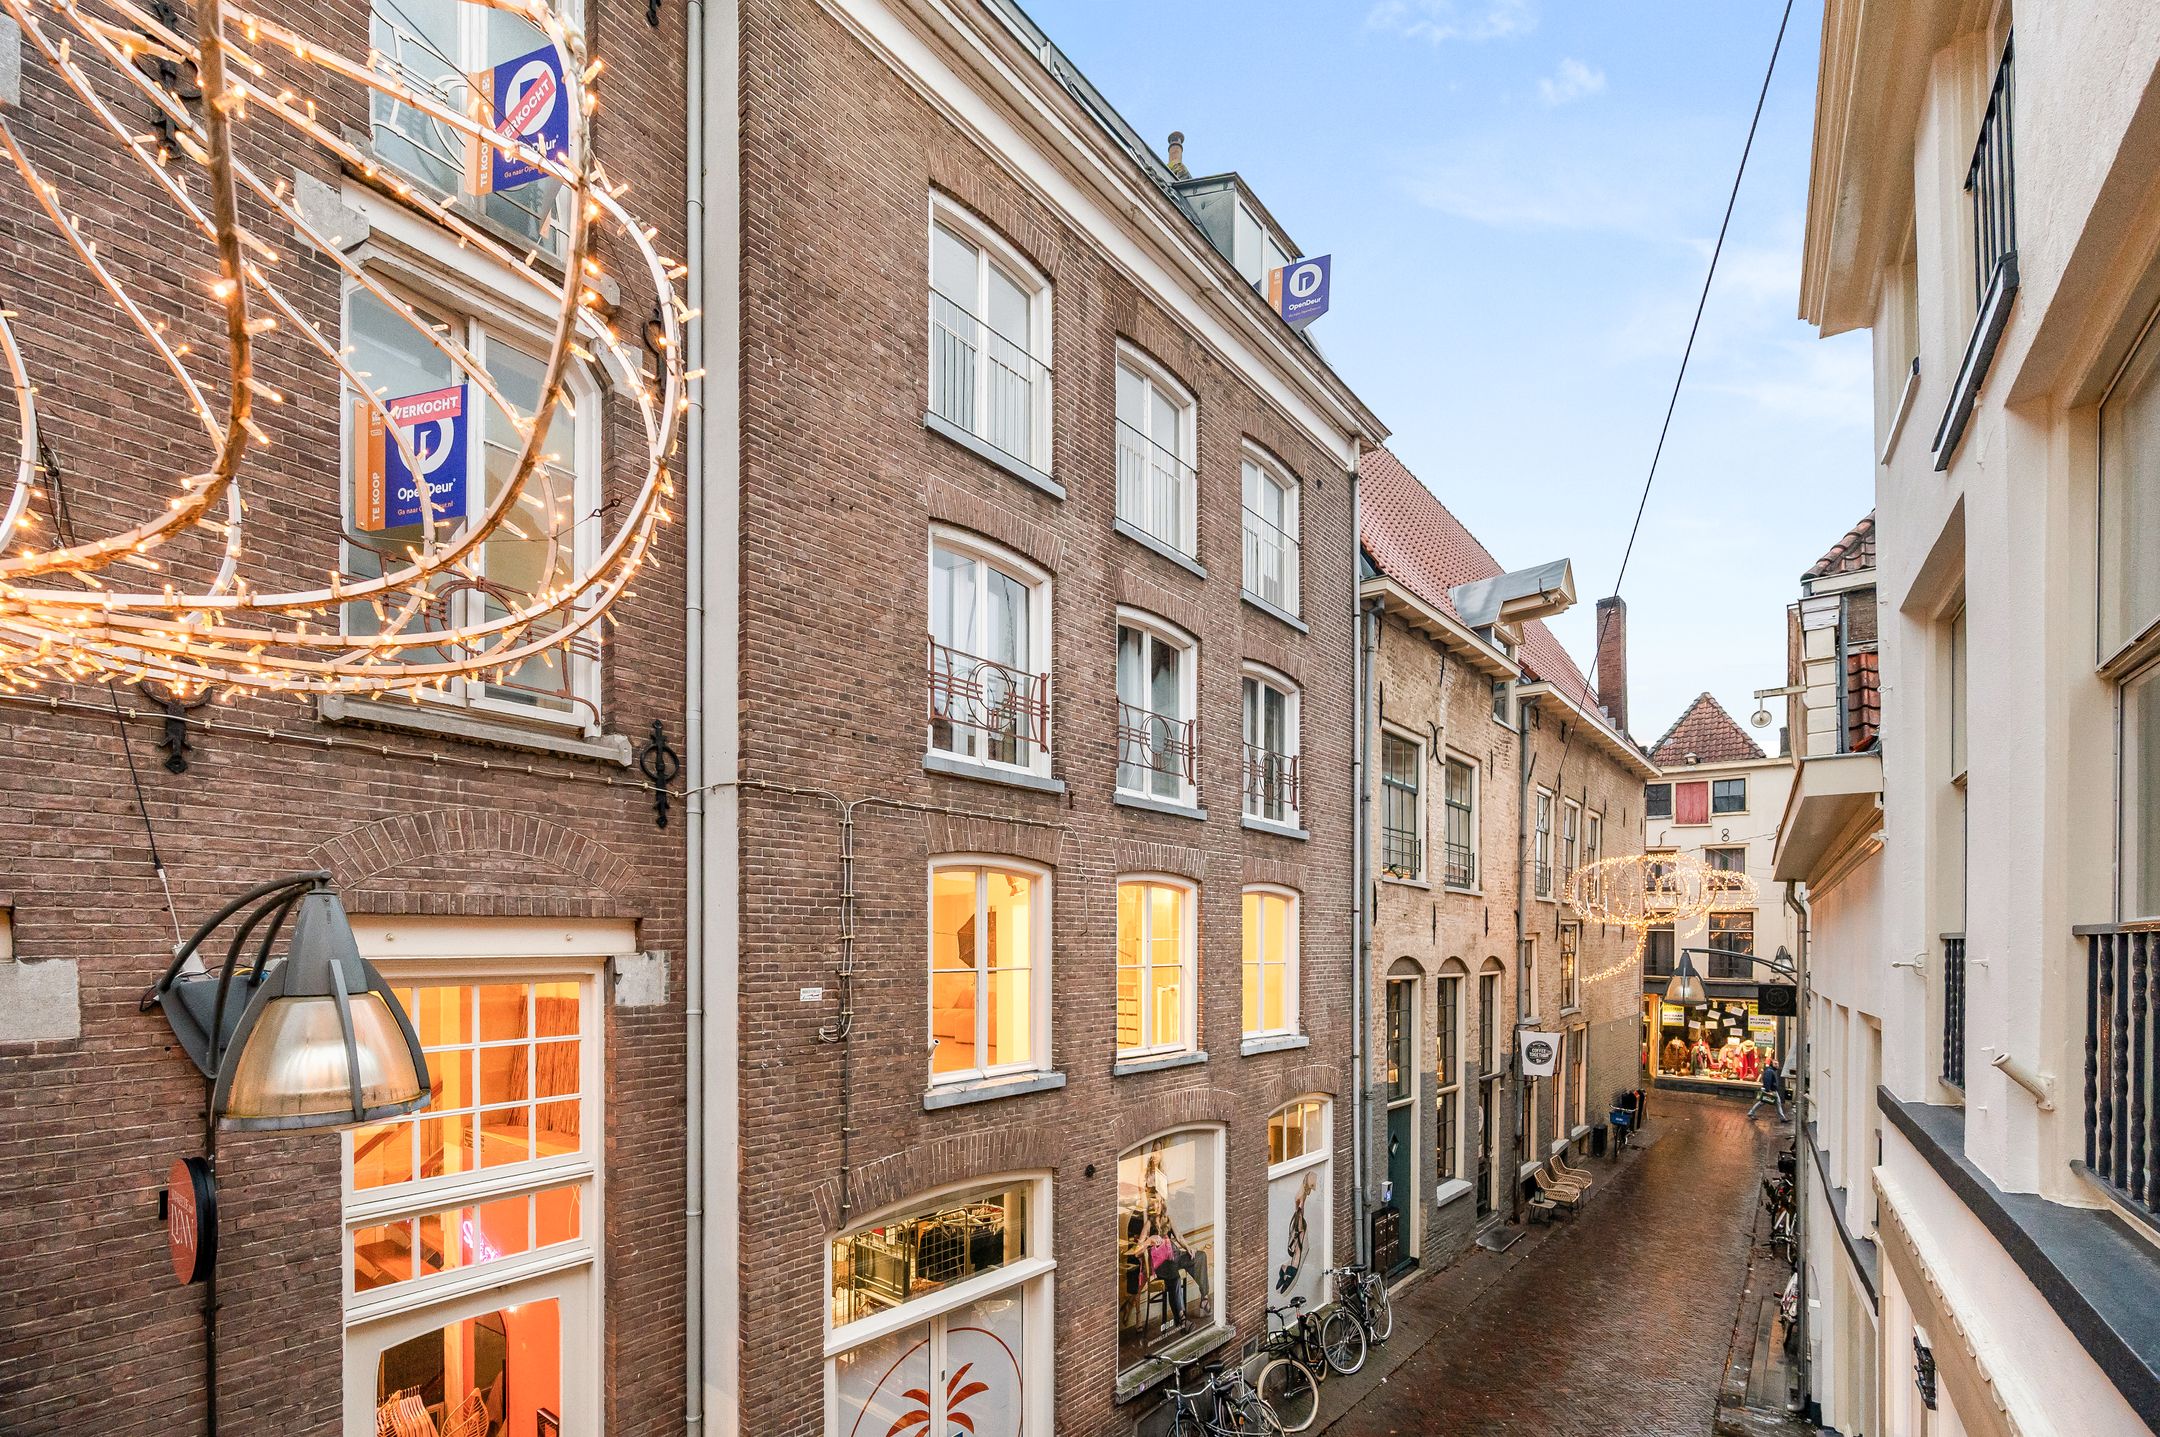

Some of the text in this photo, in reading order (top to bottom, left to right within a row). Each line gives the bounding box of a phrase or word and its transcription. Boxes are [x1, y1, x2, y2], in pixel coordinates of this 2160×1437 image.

[1288, 297, 1322, 311] OpenDeur
[372, 472, 380, 522] TE KOOP
[397, 482, 454, 502] OpeDeur
